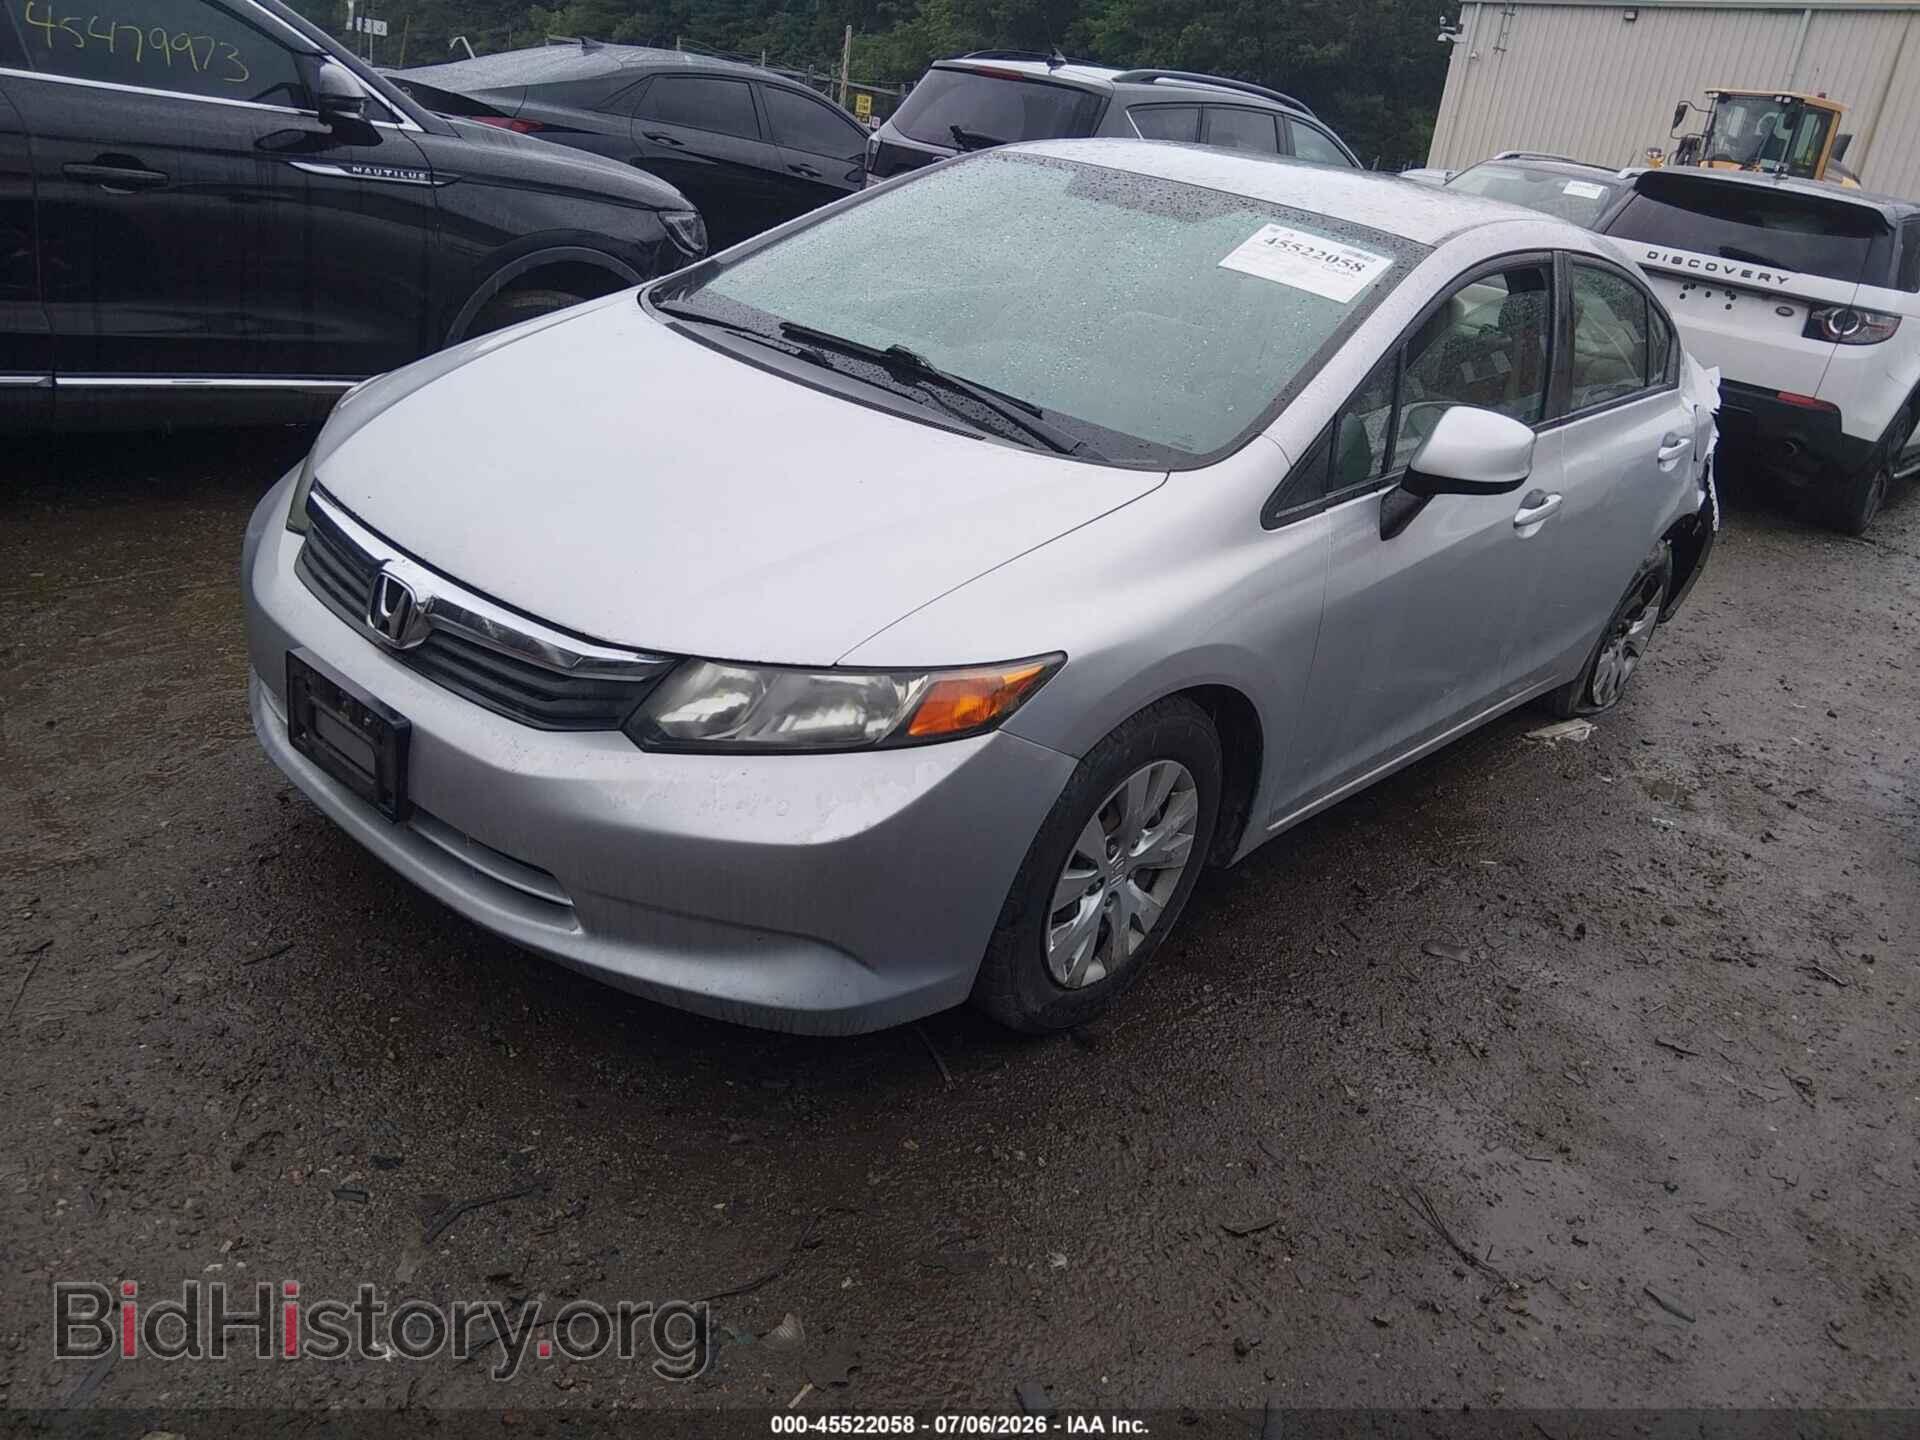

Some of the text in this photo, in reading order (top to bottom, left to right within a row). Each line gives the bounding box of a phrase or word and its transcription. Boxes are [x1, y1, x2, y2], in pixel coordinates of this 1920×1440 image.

[25, 1, 249, 82] 45479973
[352, 166, 426, 180] NAUTILUS
[1263, 236, 1366, 273] 45522058
[1646, 251, 1790, 285] DISCOVERY
